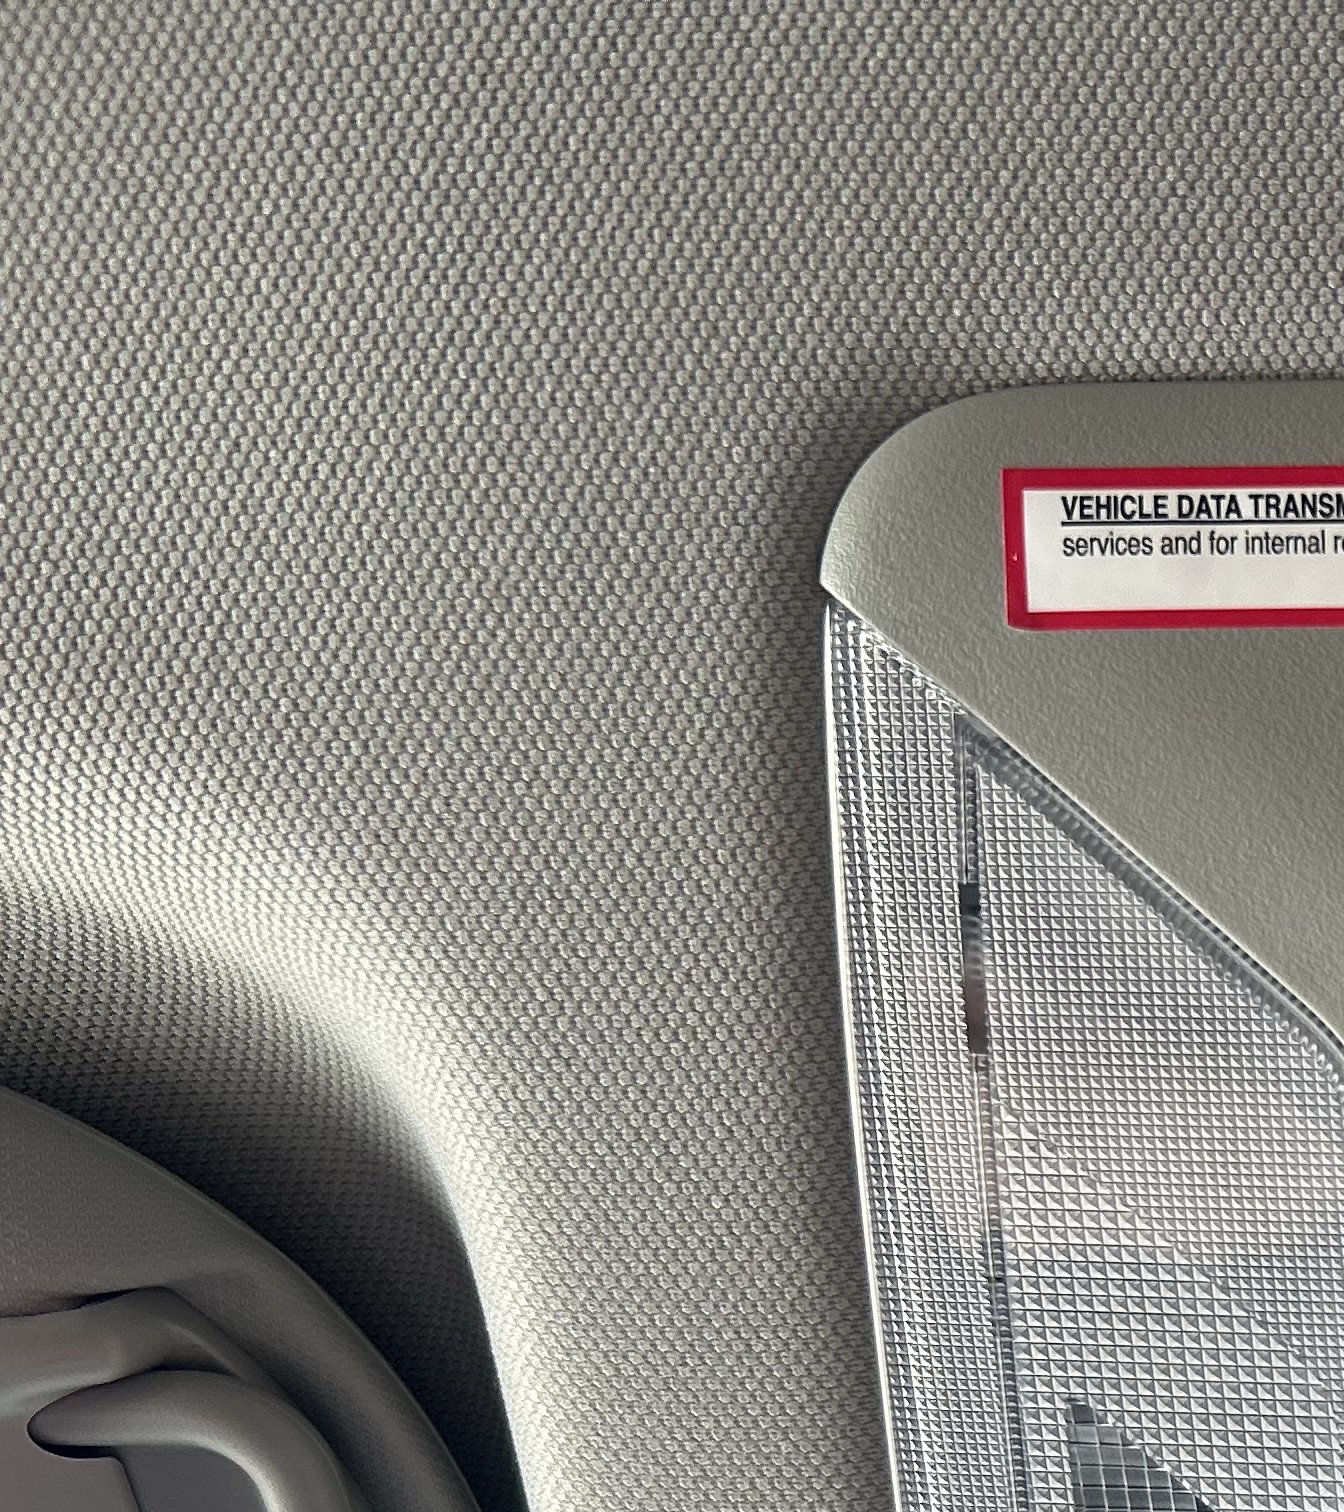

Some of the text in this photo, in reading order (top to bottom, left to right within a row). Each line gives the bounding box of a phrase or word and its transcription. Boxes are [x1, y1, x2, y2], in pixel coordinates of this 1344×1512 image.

[1060, 494, 1170, 520] VEHICLE
[1176, 493, 1243, 520] DATA
[1062, 531, 1154, 557] services
[1160, 530, 1202, 556] and
[1208, 529, 1239, 556] for
[1245, 529, 1326, 555] internal
